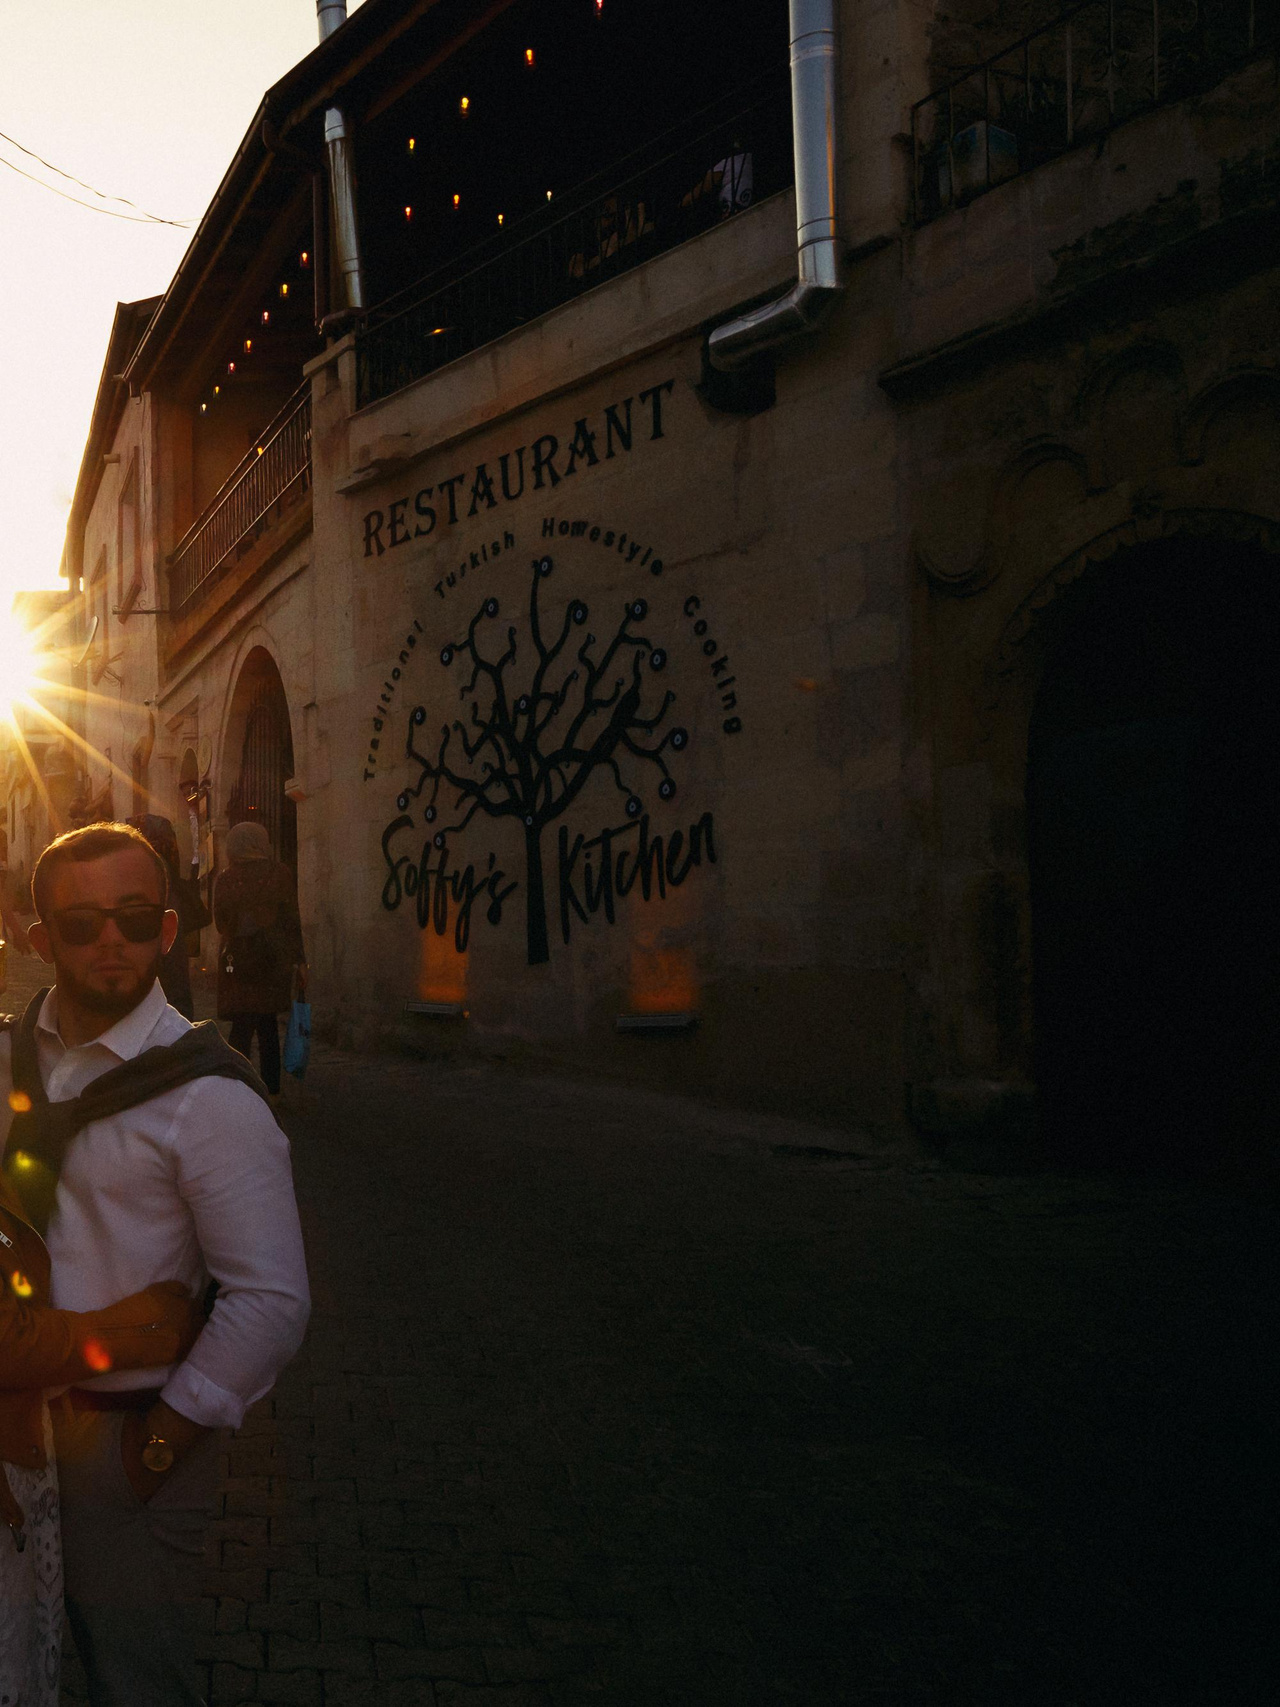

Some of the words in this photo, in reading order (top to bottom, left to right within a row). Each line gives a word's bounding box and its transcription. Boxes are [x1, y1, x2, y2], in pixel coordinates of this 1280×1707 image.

[362, 379, 675, 558] RESTAURANT
[363, 619, 423, 782] Traditional
[433, 530, 516, 599] Turkish
[541, 516, 664, 576] Homestyle
[683, 594, 742, 734] Cooking
[381, 814, 519, 954] Soffy's
[558, 811, 717, 945] Kitchen
